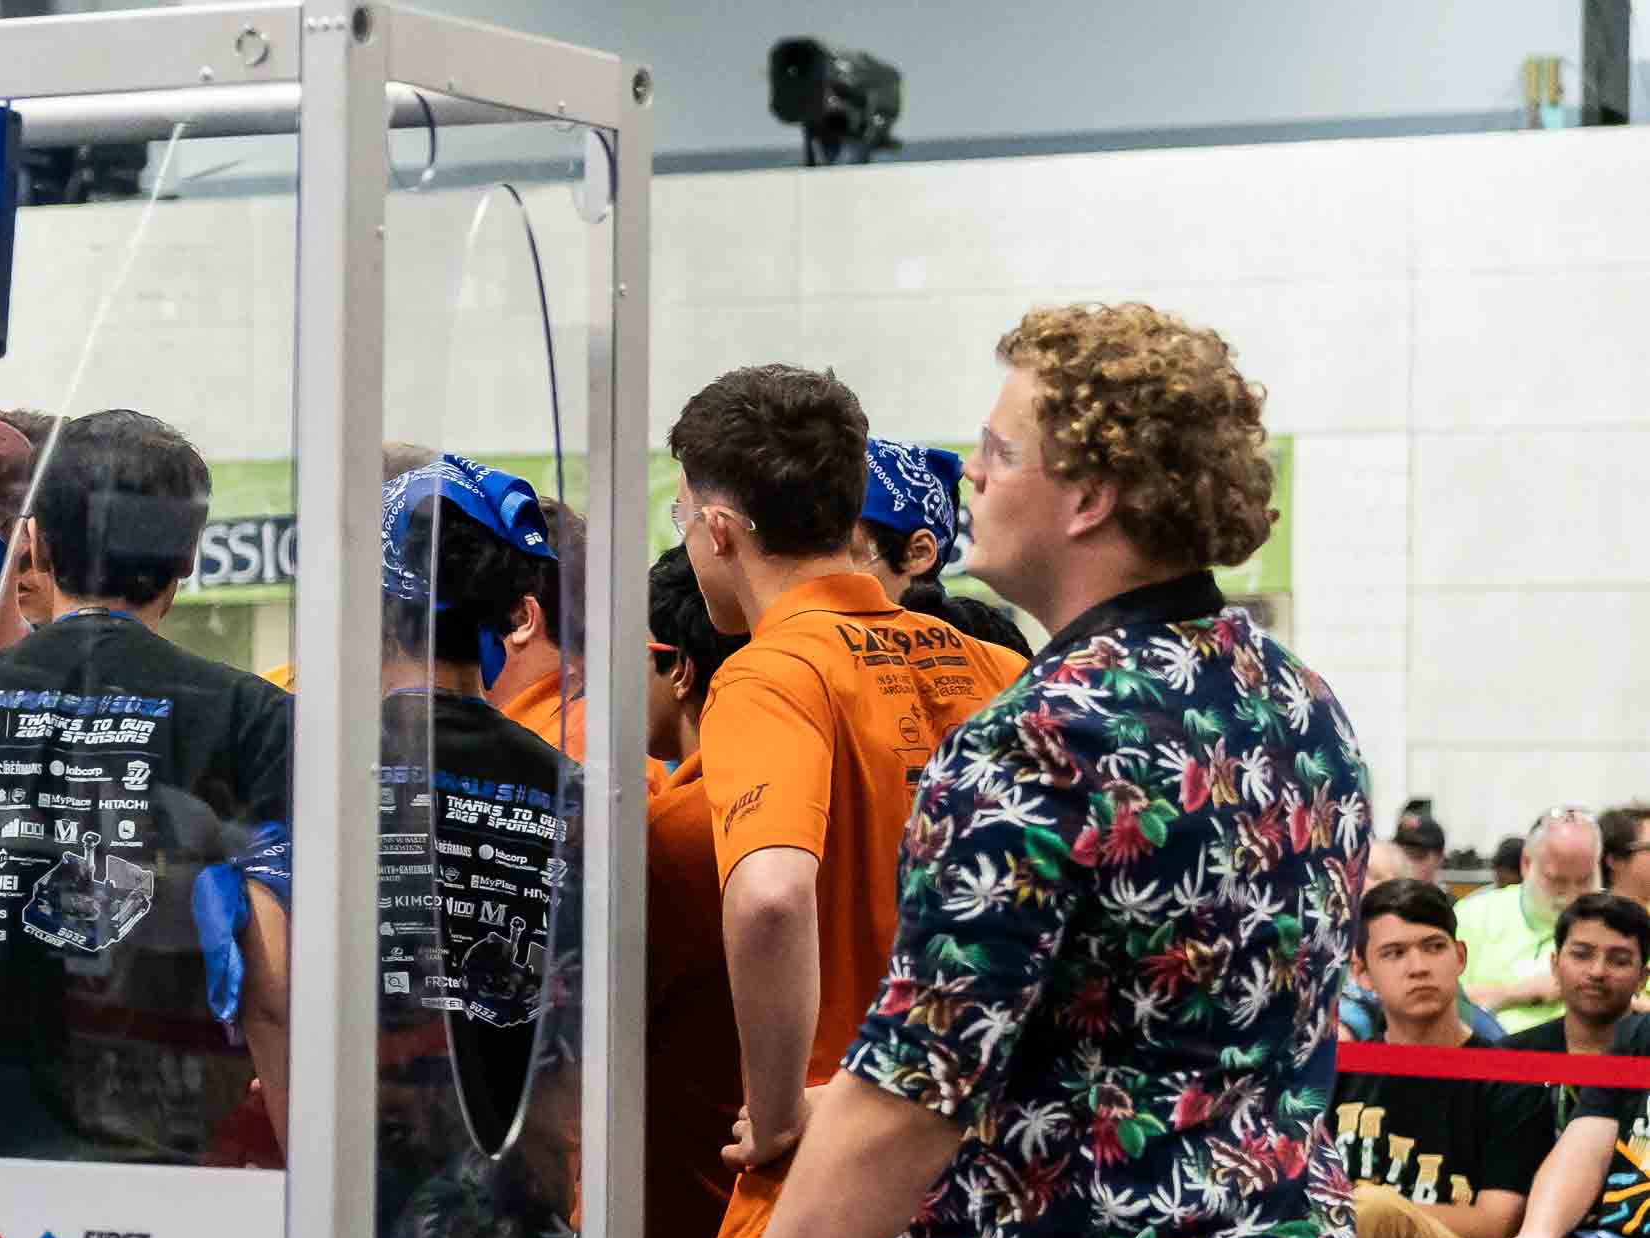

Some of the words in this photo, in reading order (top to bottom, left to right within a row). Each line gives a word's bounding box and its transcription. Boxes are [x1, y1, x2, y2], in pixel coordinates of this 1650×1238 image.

[16, 712, 83, 731] THANKS
[93, 719, 112, 731] TO
[119, 718, 156, 733] OUR
[59, 730, 151, 744] SPONSORS
[66, 765, 103, 777] labcorp
[99, 800, 149, 811] HITACHI
[446, 795, 504, 817] THANKS
[512, 808, 533, 821] TO
[446, 808, 479, 824] 2026
[395, 896, 442, 907] KIMCO
